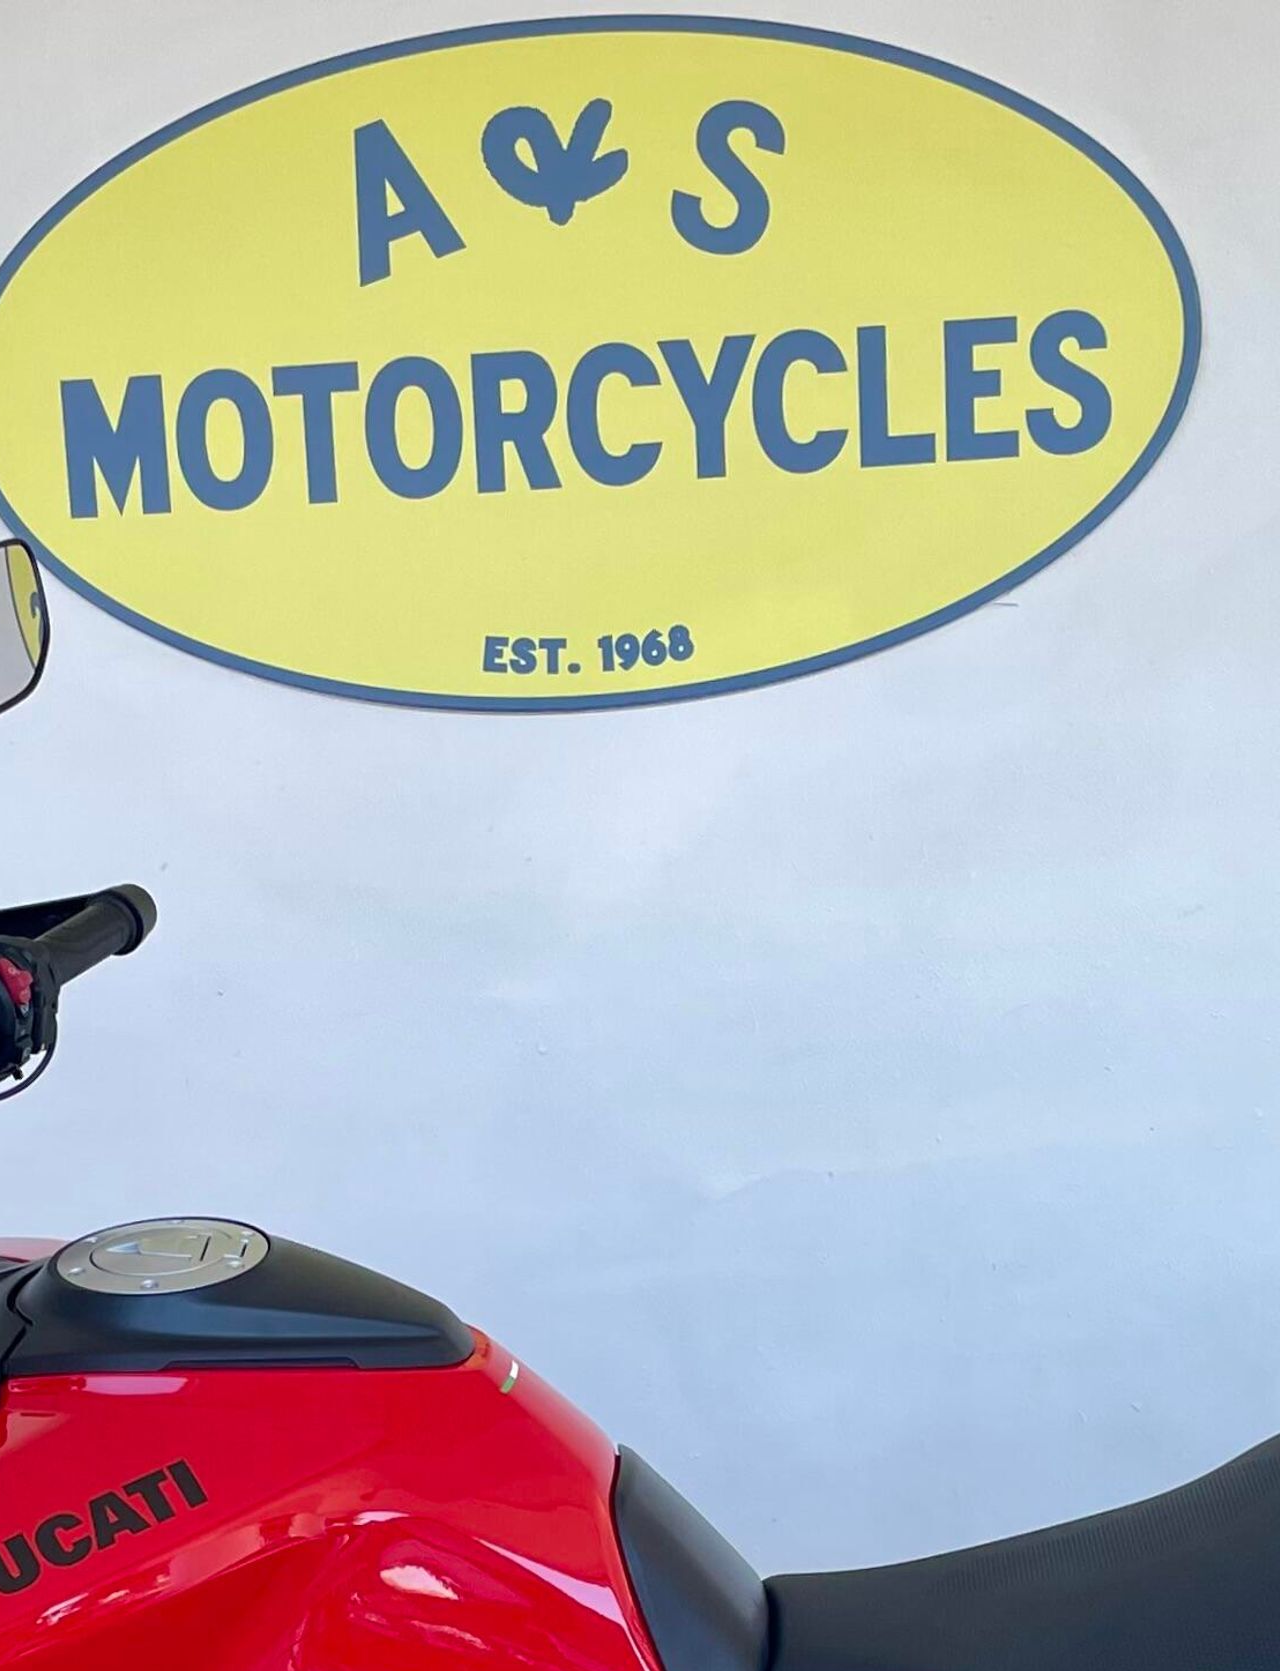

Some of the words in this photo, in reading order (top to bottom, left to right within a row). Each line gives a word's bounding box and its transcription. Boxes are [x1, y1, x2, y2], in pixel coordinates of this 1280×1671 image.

[354, 119, 465, 285] A
[671, 99, 785, 256] S
[60, 308, 1113, 520] MOTORCYCLES
[482, 635, 582, 676] EST.
[597, 624, 695, 673] 1968
